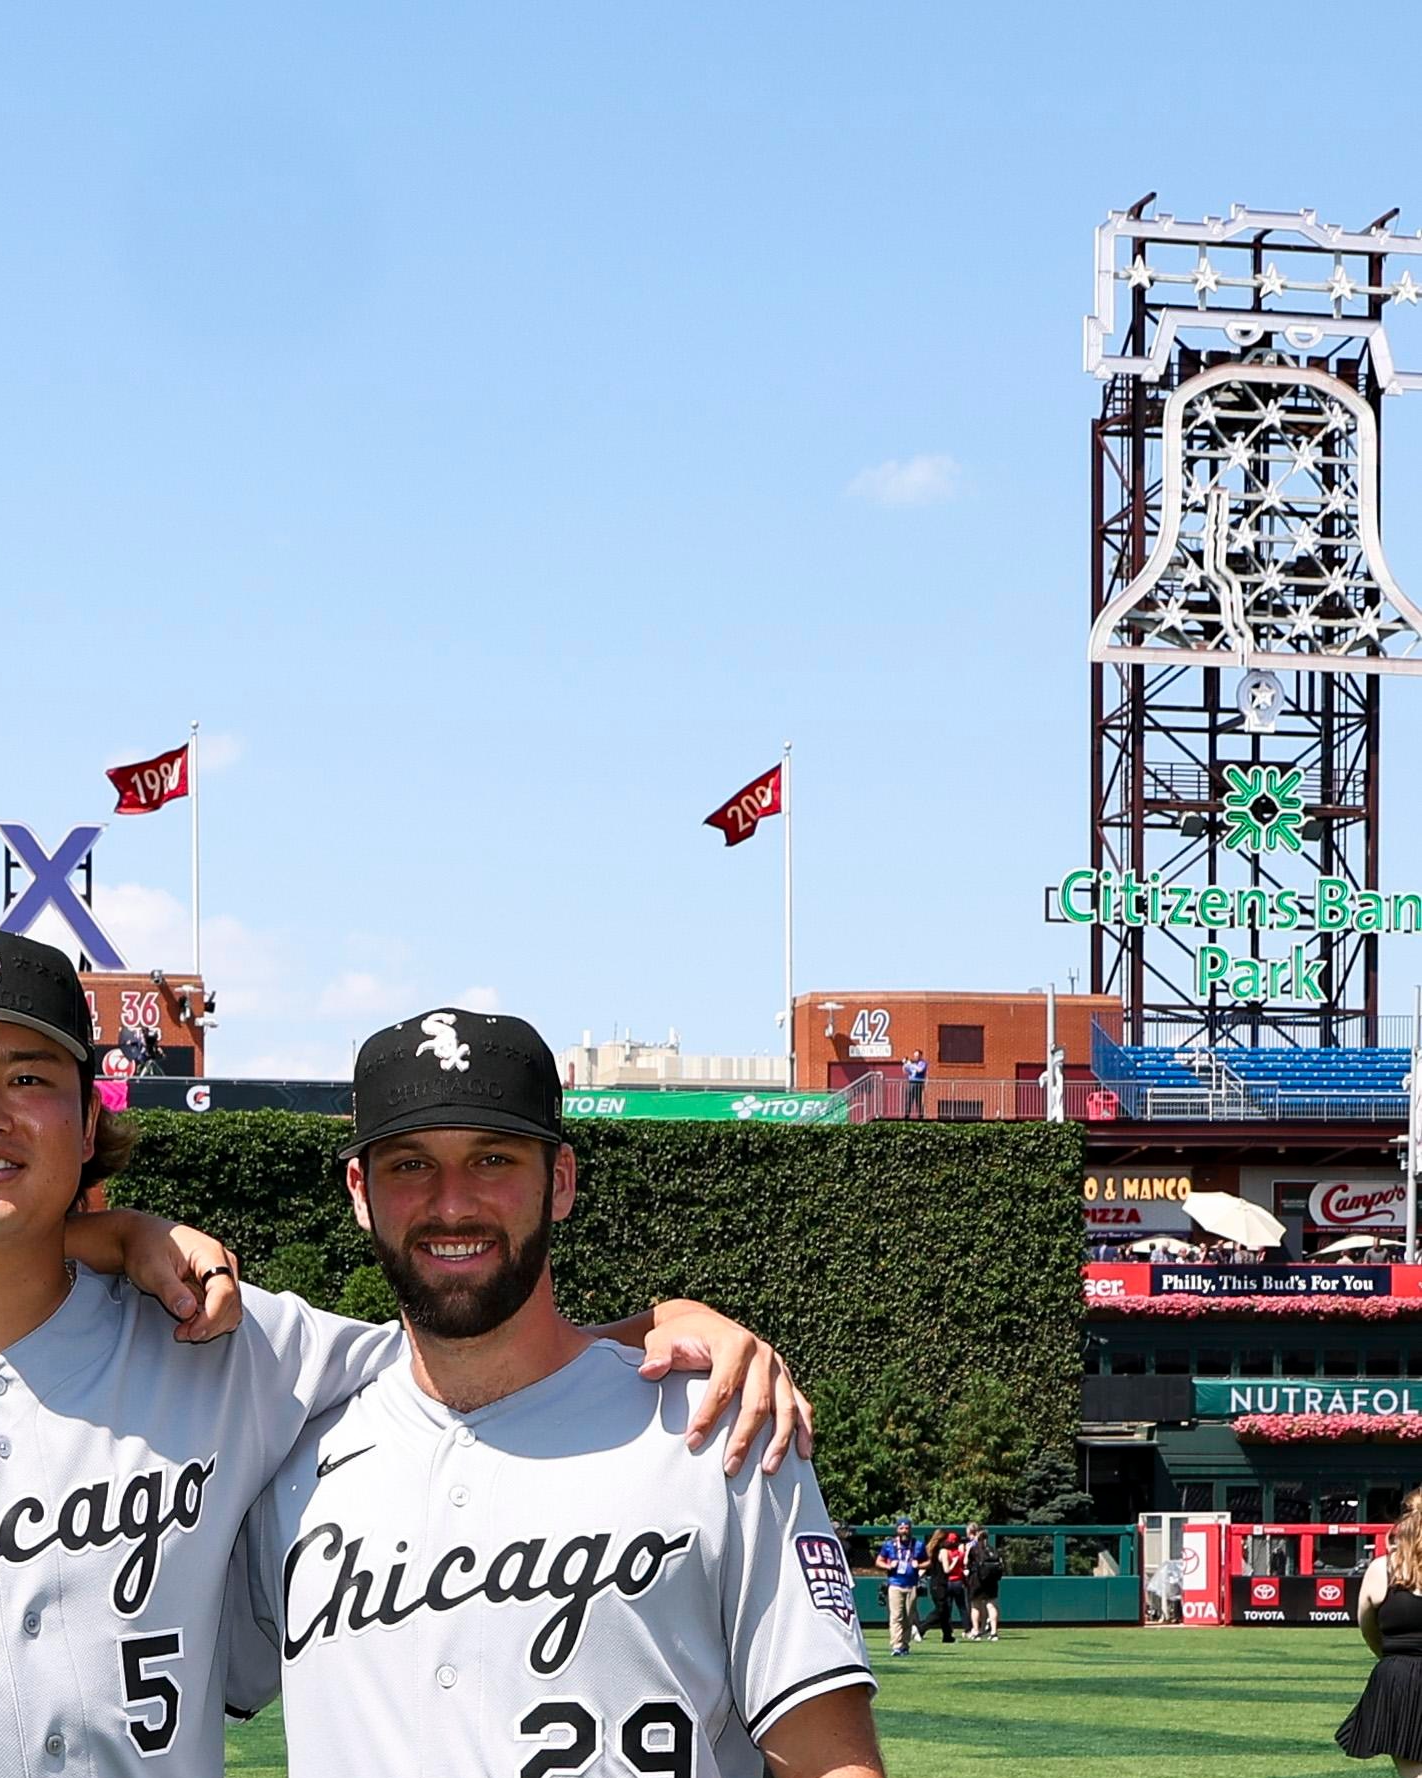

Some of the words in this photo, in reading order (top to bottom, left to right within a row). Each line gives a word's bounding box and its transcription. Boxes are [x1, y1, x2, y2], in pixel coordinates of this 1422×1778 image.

[1058, 867, 1299, 930] Citizens
[1195, 942, 1329, 1002] Park
[121, 991, 160, 1027] 36
[850, 1009, 890, 1045] 42
[563, 1098, 596, 1114] TO
[596, 1098, 626, 1114] EN
[762, 1101, 798, 1117] ITO
[1104, 1177, 1117, 1201] &
[1123, 1177, 1192, 1201] MANCO
[1321, 1183, 1406, 1225] Campo's
[1084, 1276, 1126, 1298] ser.
[1161, 1275, 1216, 1293] Philly,
[1219, 1274, 1256, 1291] This
[1262, 1275, 1307, 1291] Bud's
[1310, 1275, 1339, 1291] For
[1343, 1275, 1375, 1292] You
[1230, 1386, 1420, 1416] NUTRAFOL
[800, 1541, 844, 1569] USA
[282, 1521, 700, 1679] Chicago
[1183, 1602, 1218, 1619] OTA
[1243, 1610, 1286, 1621] TOYOTA
[1309, 1611, 1351, 1622] TOYOTA
[116, 1627, 184, 1759] 5
